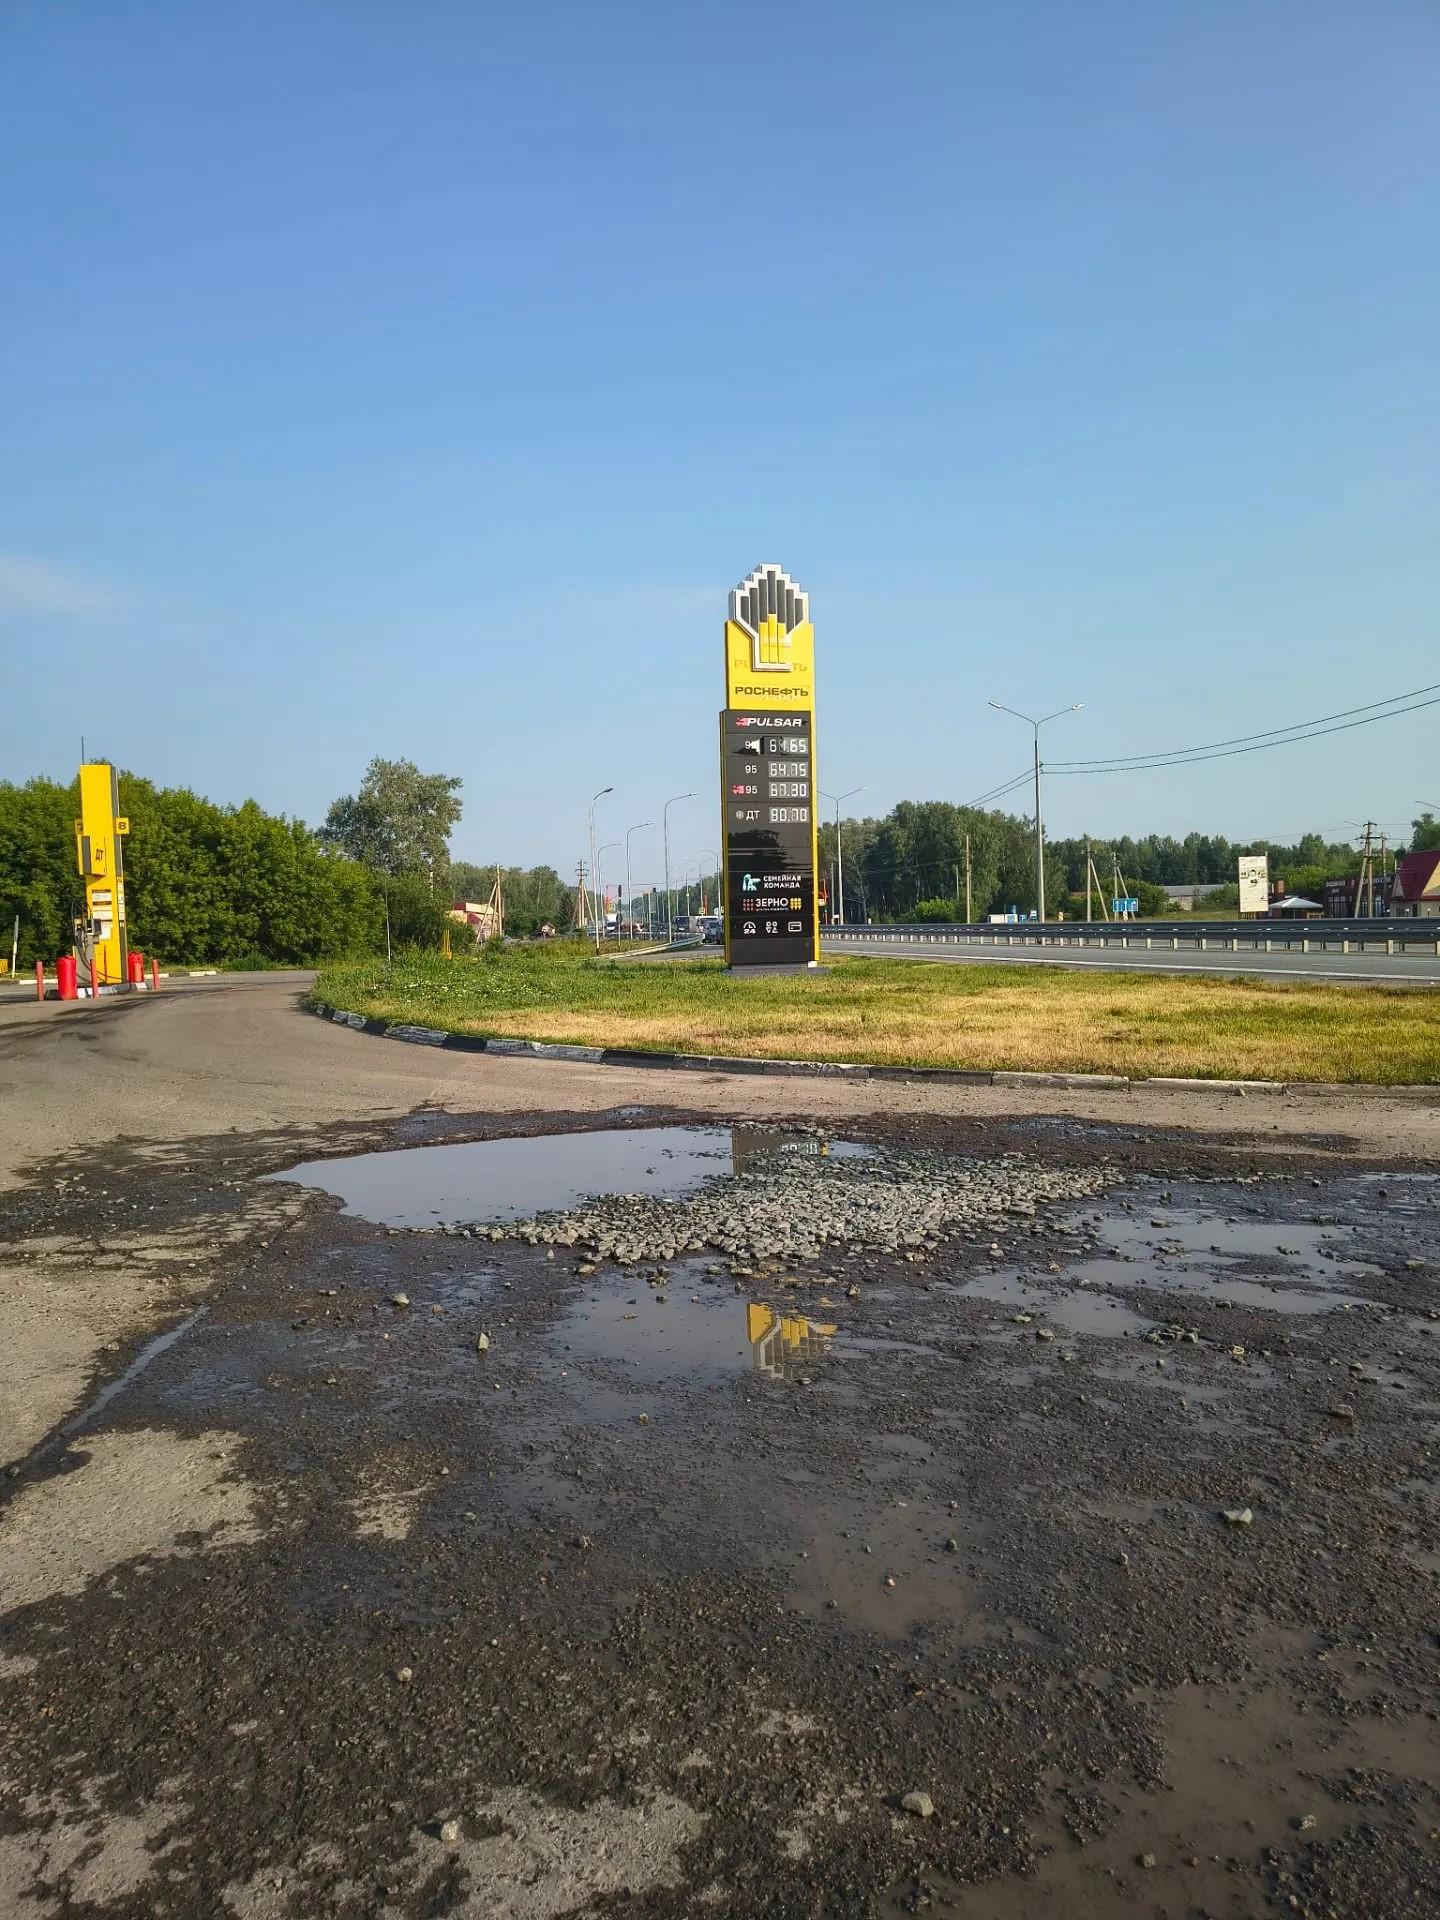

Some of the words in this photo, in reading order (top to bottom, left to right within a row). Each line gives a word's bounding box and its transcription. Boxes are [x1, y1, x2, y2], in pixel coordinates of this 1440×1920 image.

[735, 687, 809, 697] РОСНЕФТЬ
[746, 717, 802, 728] PULSAR
[745, 765, 758, 774] 95
[770, 763, 807, 777] 64.75
[745, 786, 758, 794] 95
[745, 811, 760, 821] ДТ
[763, 874, 802, 882] СЕМЕЙНАЯ
[755, 898, 789, 907] ЗЕРНО
